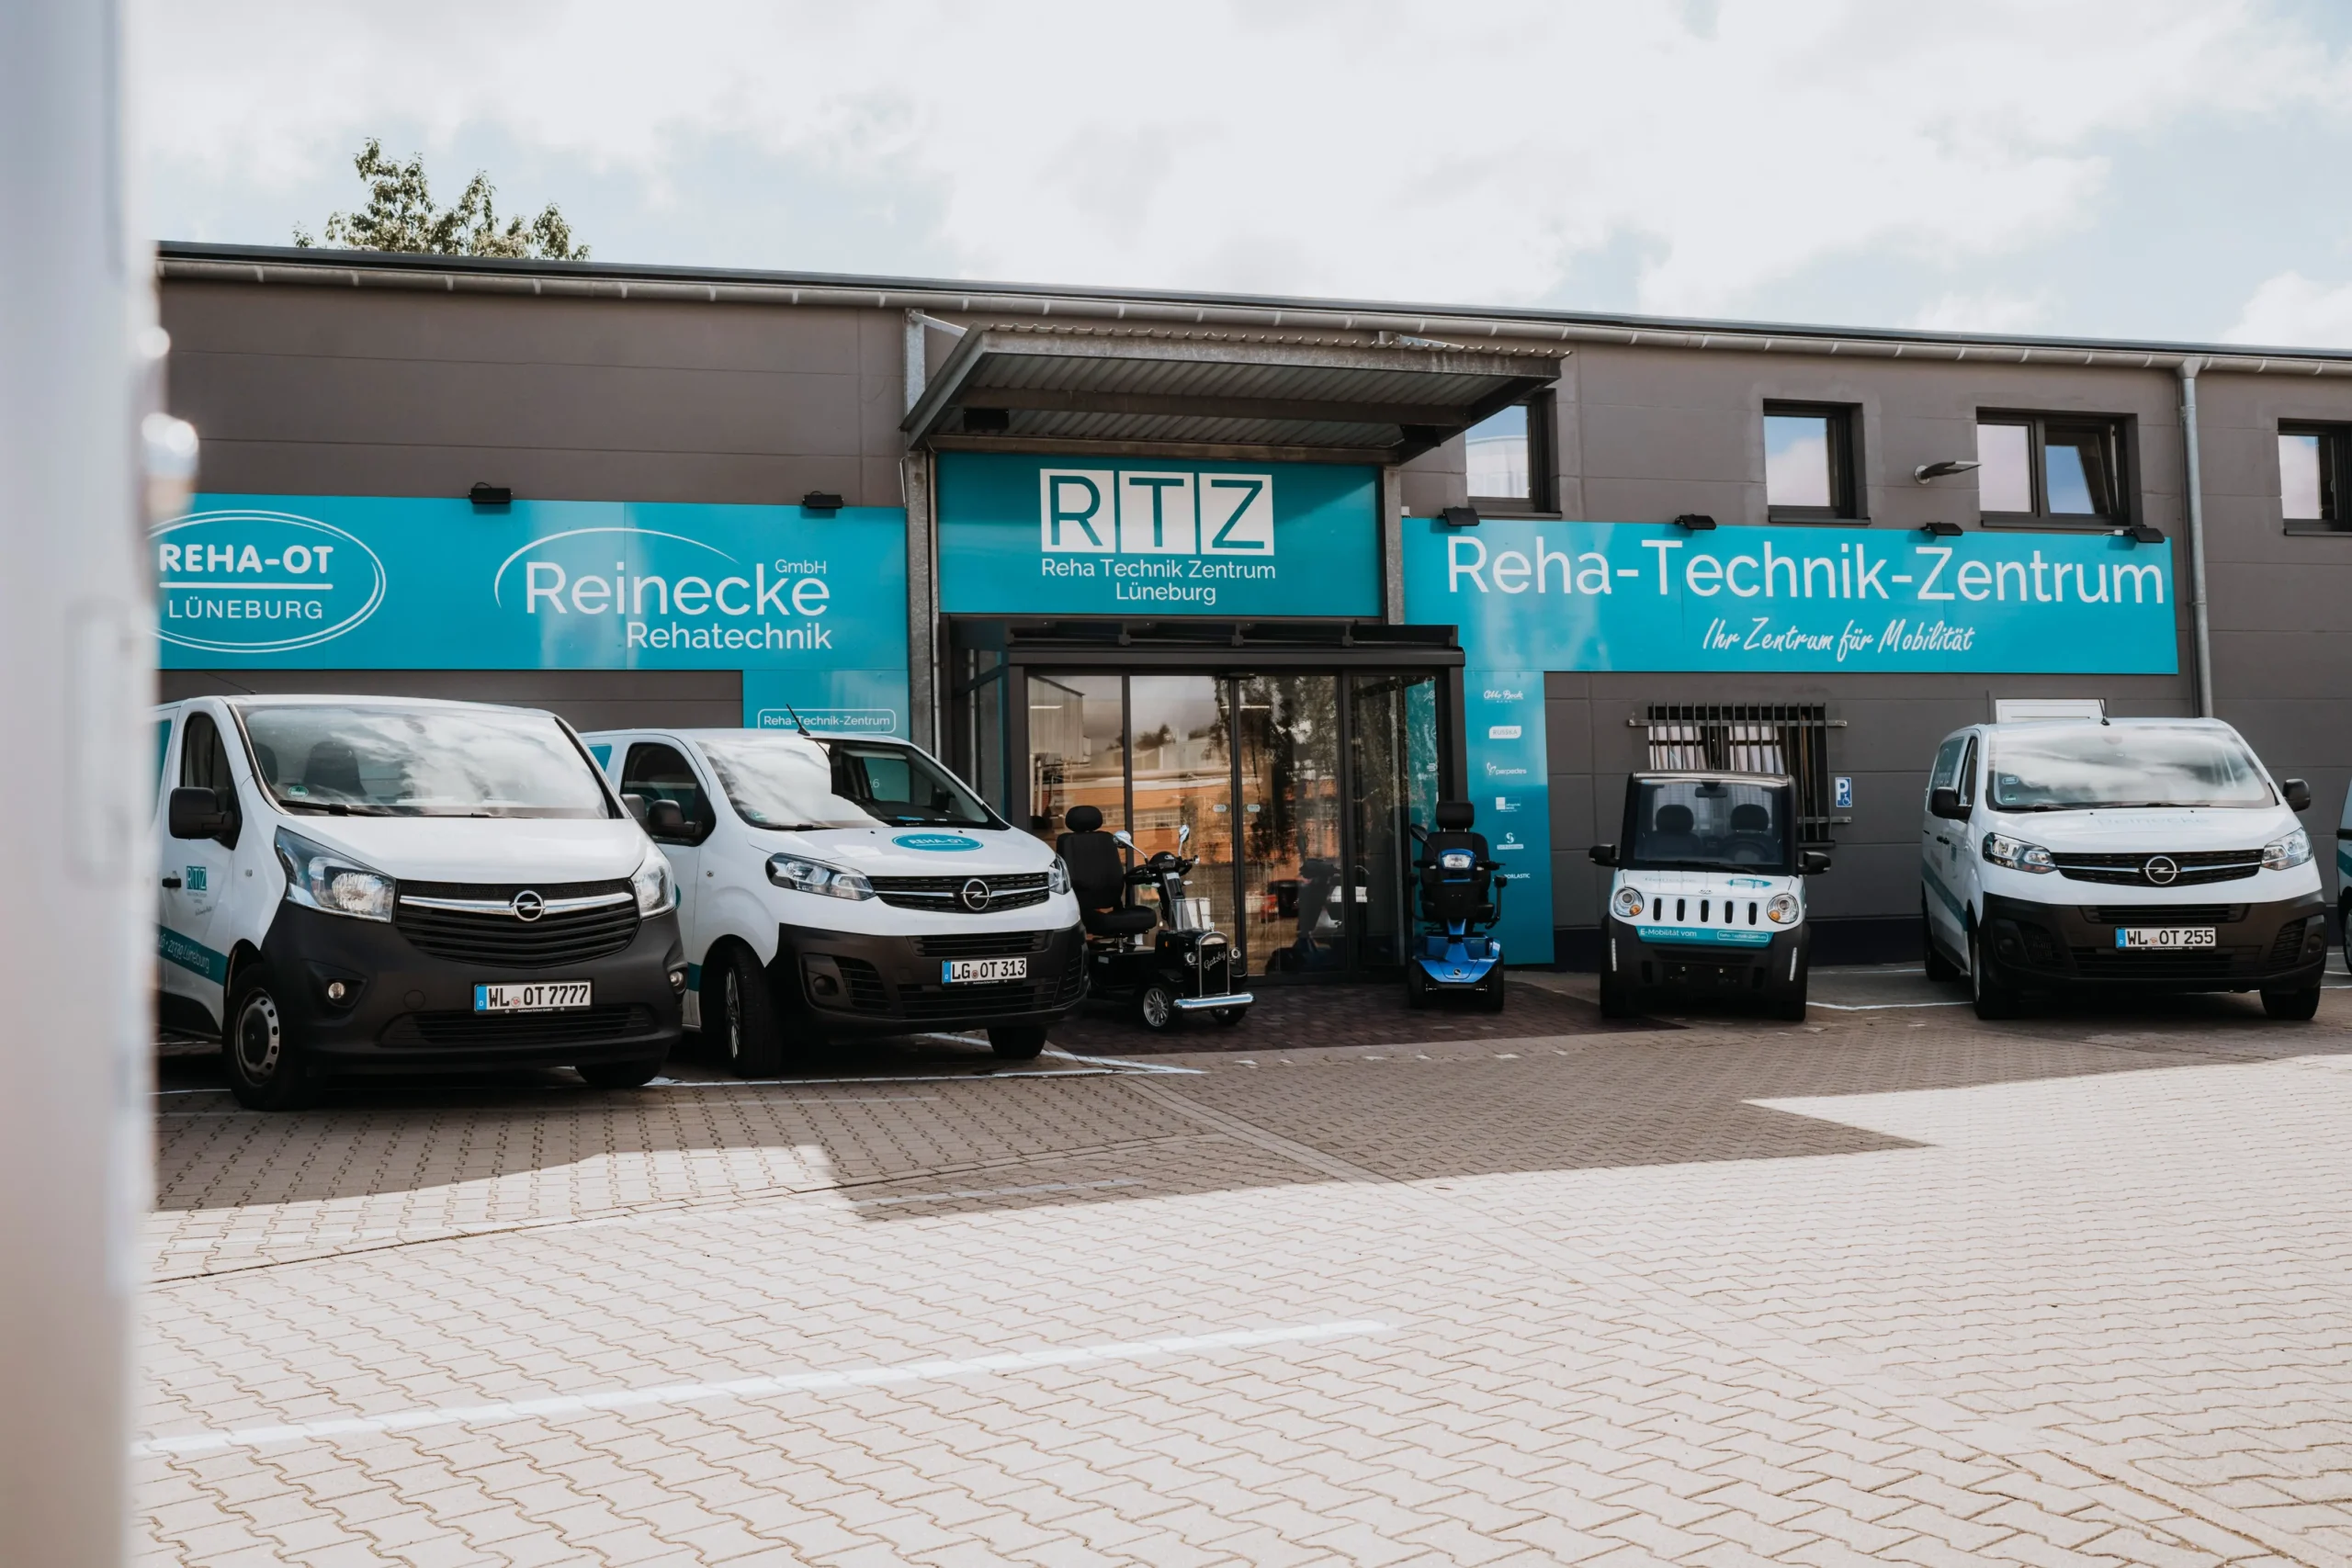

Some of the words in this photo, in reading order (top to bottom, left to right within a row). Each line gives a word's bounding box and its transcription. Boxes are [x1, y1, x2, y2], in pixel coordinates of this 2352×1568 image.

[1049, 475, 1265, 549] RTZ
[159, 544, 334, 574] REHA-OT
[775, 558, 827, 575] GmbH
[1042, 558, 1095, 577] Reha
[1100, 558, 1183, 579] Technik
[1188, 560, 1276, 580] Zentrum
[1447, 536, 2165, 604] Reha-Technik-Zentrum
[526, 561, 830, 616] Reinecke
[1116, 582, 1216, 605] Lüneburg
[168, 595, 322, 620] LÜNEBURG
[627, 621, 832, 649] Rehatechnik
[1702, 617, 1740, 649] Ihr
[1744, 617, 1835, 652] Zentrum
[1837, 620, 1874, 662] für
[1877, 619, 1975, 653] Mobilität
[763, 716, 890, 726] Reha-Technik-Zentrum
[1837, 779, 1849, 800] P
[187, 866, 207, 890] RTZ
[1640, 928, 1679, 938] E-Mobilität
[2127, 931, 2148, 945] WL
[2159, 931, 2179, 944] OT
[2184, 930, 2213, 944] 255
[183, 944, 209, 974] Lüneburg
[952, 963, 970, 979] LG
[980, 962, 997, 978] OT
[1001, 960, 1025, 976] 313
[1204, 951, 1227, 971] Gatsby
[489, 988, 510, 1007] WL
[524, 987, 544, 1005] OT
[549, 985, 588, 1004] 7777
